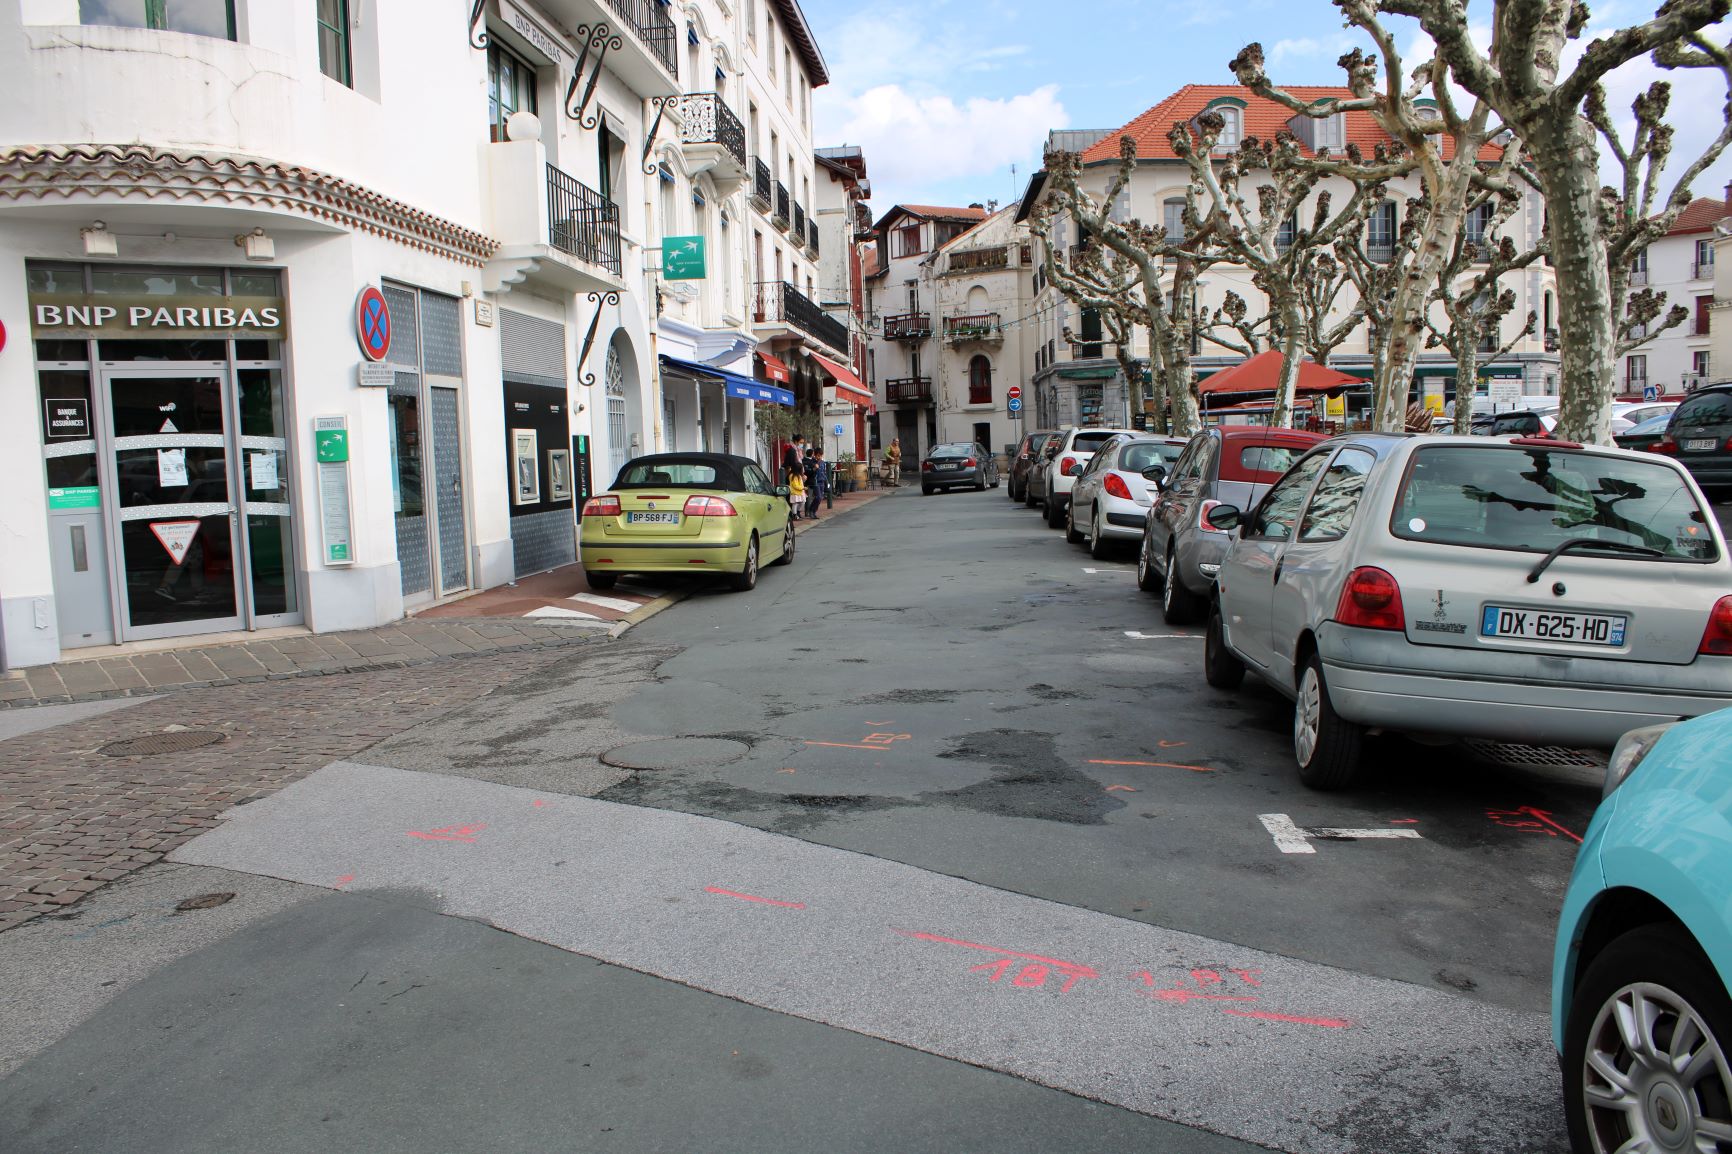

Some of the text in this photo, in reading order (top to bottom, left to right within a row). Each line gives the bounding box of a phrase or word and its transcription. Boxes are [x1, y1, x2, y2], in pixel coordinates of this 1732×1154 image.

[515, 14, 562, 63] BNP PARIBAS
[35, 304, 281, 328] BNP PARIBAS
[57, 408, 77, 416] BANQUE
[319, 420, 342, 428] CONSEIL
[633, 513, 673, 522] BP-568-FJ
[1487, 623, 1493, 631] F
[1499, 611, 1609, 641] DX-625-HD
[1611, 632, 1623, 642] 974
